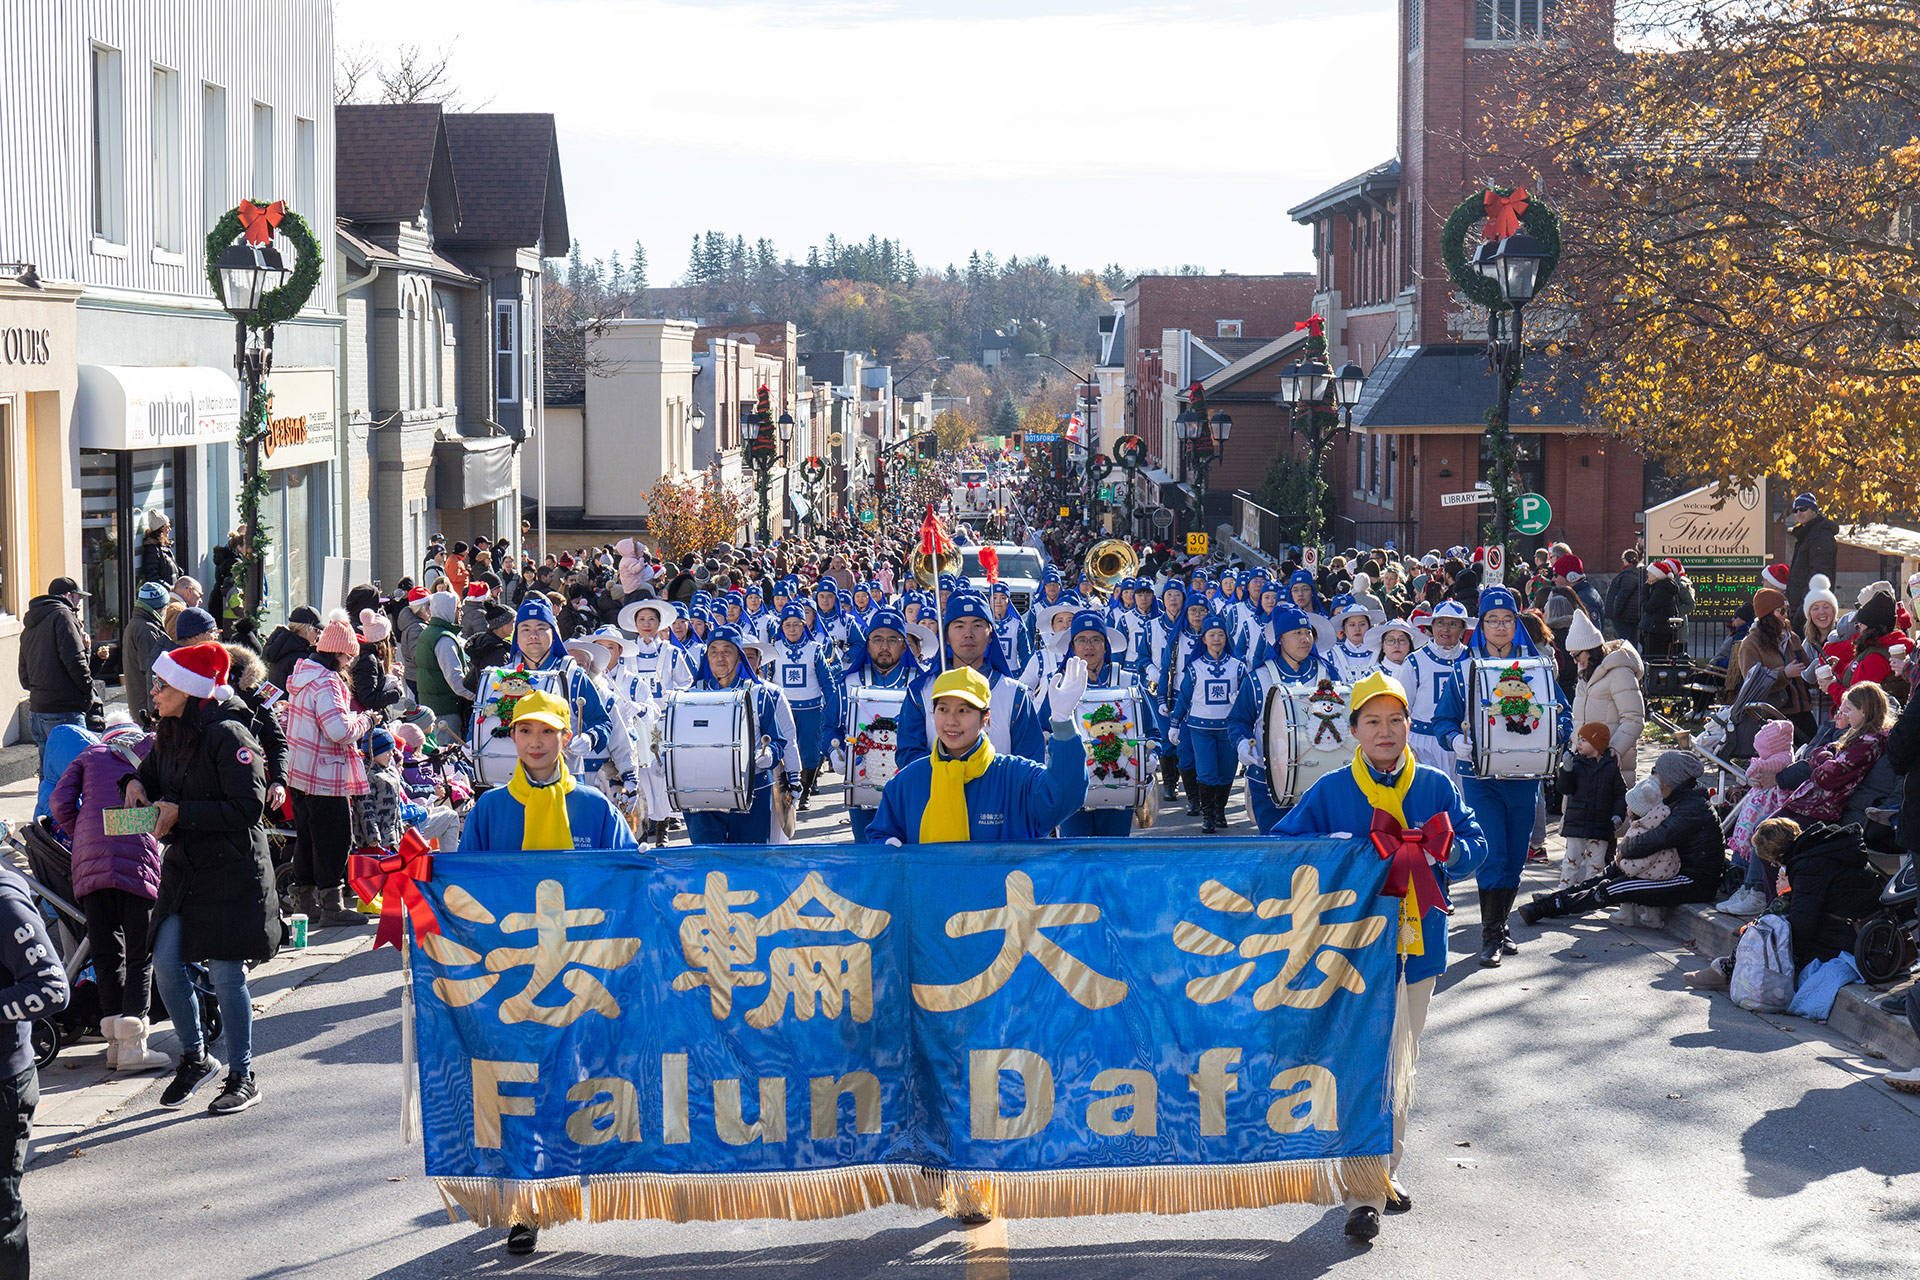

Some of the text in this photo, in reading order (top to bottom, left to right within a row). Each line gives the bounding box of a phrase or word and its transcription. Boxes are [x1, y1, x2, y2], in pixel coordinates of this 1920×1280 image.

[149, 390, 195, 445] optical
[1025, 434, 1054, 442] BOTSFORD
[1444, 494, 1475, 504] LIBRARY
[1522, 498, 1540, 520] P
[1660, 511, 1750, 548] Trinity
[1190, 534, 1205, 545] 30
[1662, 545, 1750, 554] United Church
[1717, 573, 1756, 583] Bazaar
[788, 670, 801, 682] 樂
[1211, 685, 1224, 698] 樂
[421, 865, 1387, 1028] 法輪大法
[472, 1047, 1338, 1149] Falun Dafa
